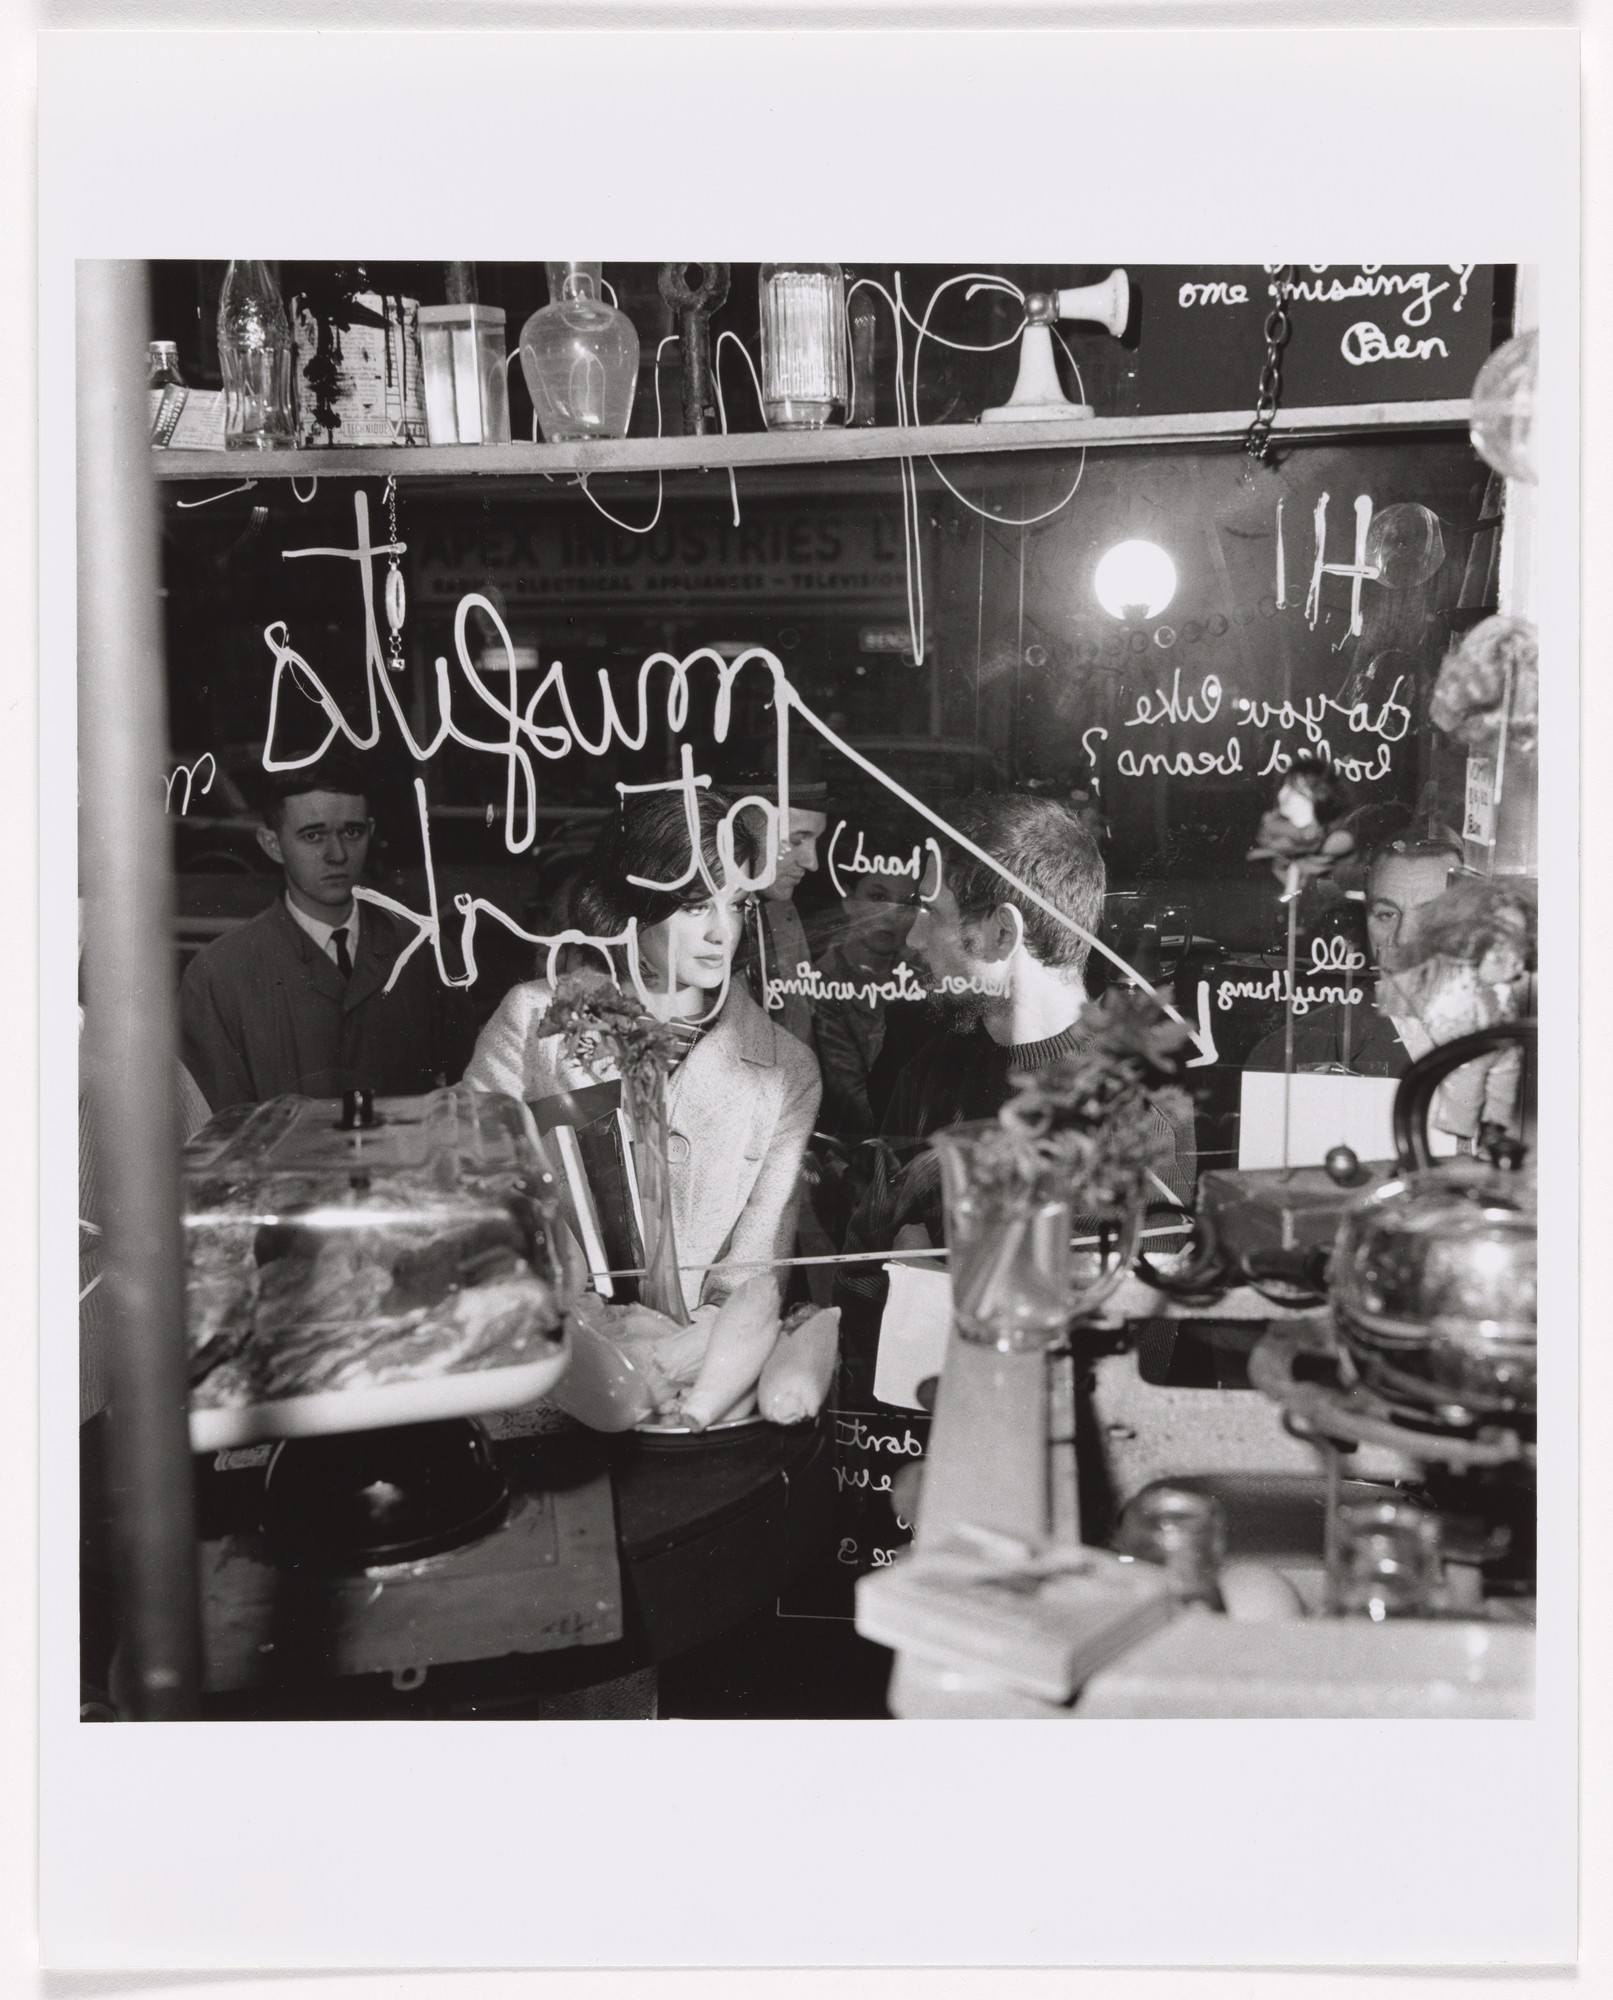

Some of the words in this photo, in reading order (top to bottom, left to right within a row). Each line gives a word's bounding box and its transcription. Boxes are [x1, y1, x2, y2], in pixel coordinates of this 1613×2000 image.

[346, 422, 388, 435] TECHNIQUE
[419, 529, 541, 569] APEX
[562, 518, 843, 567] INDUSTRIES
